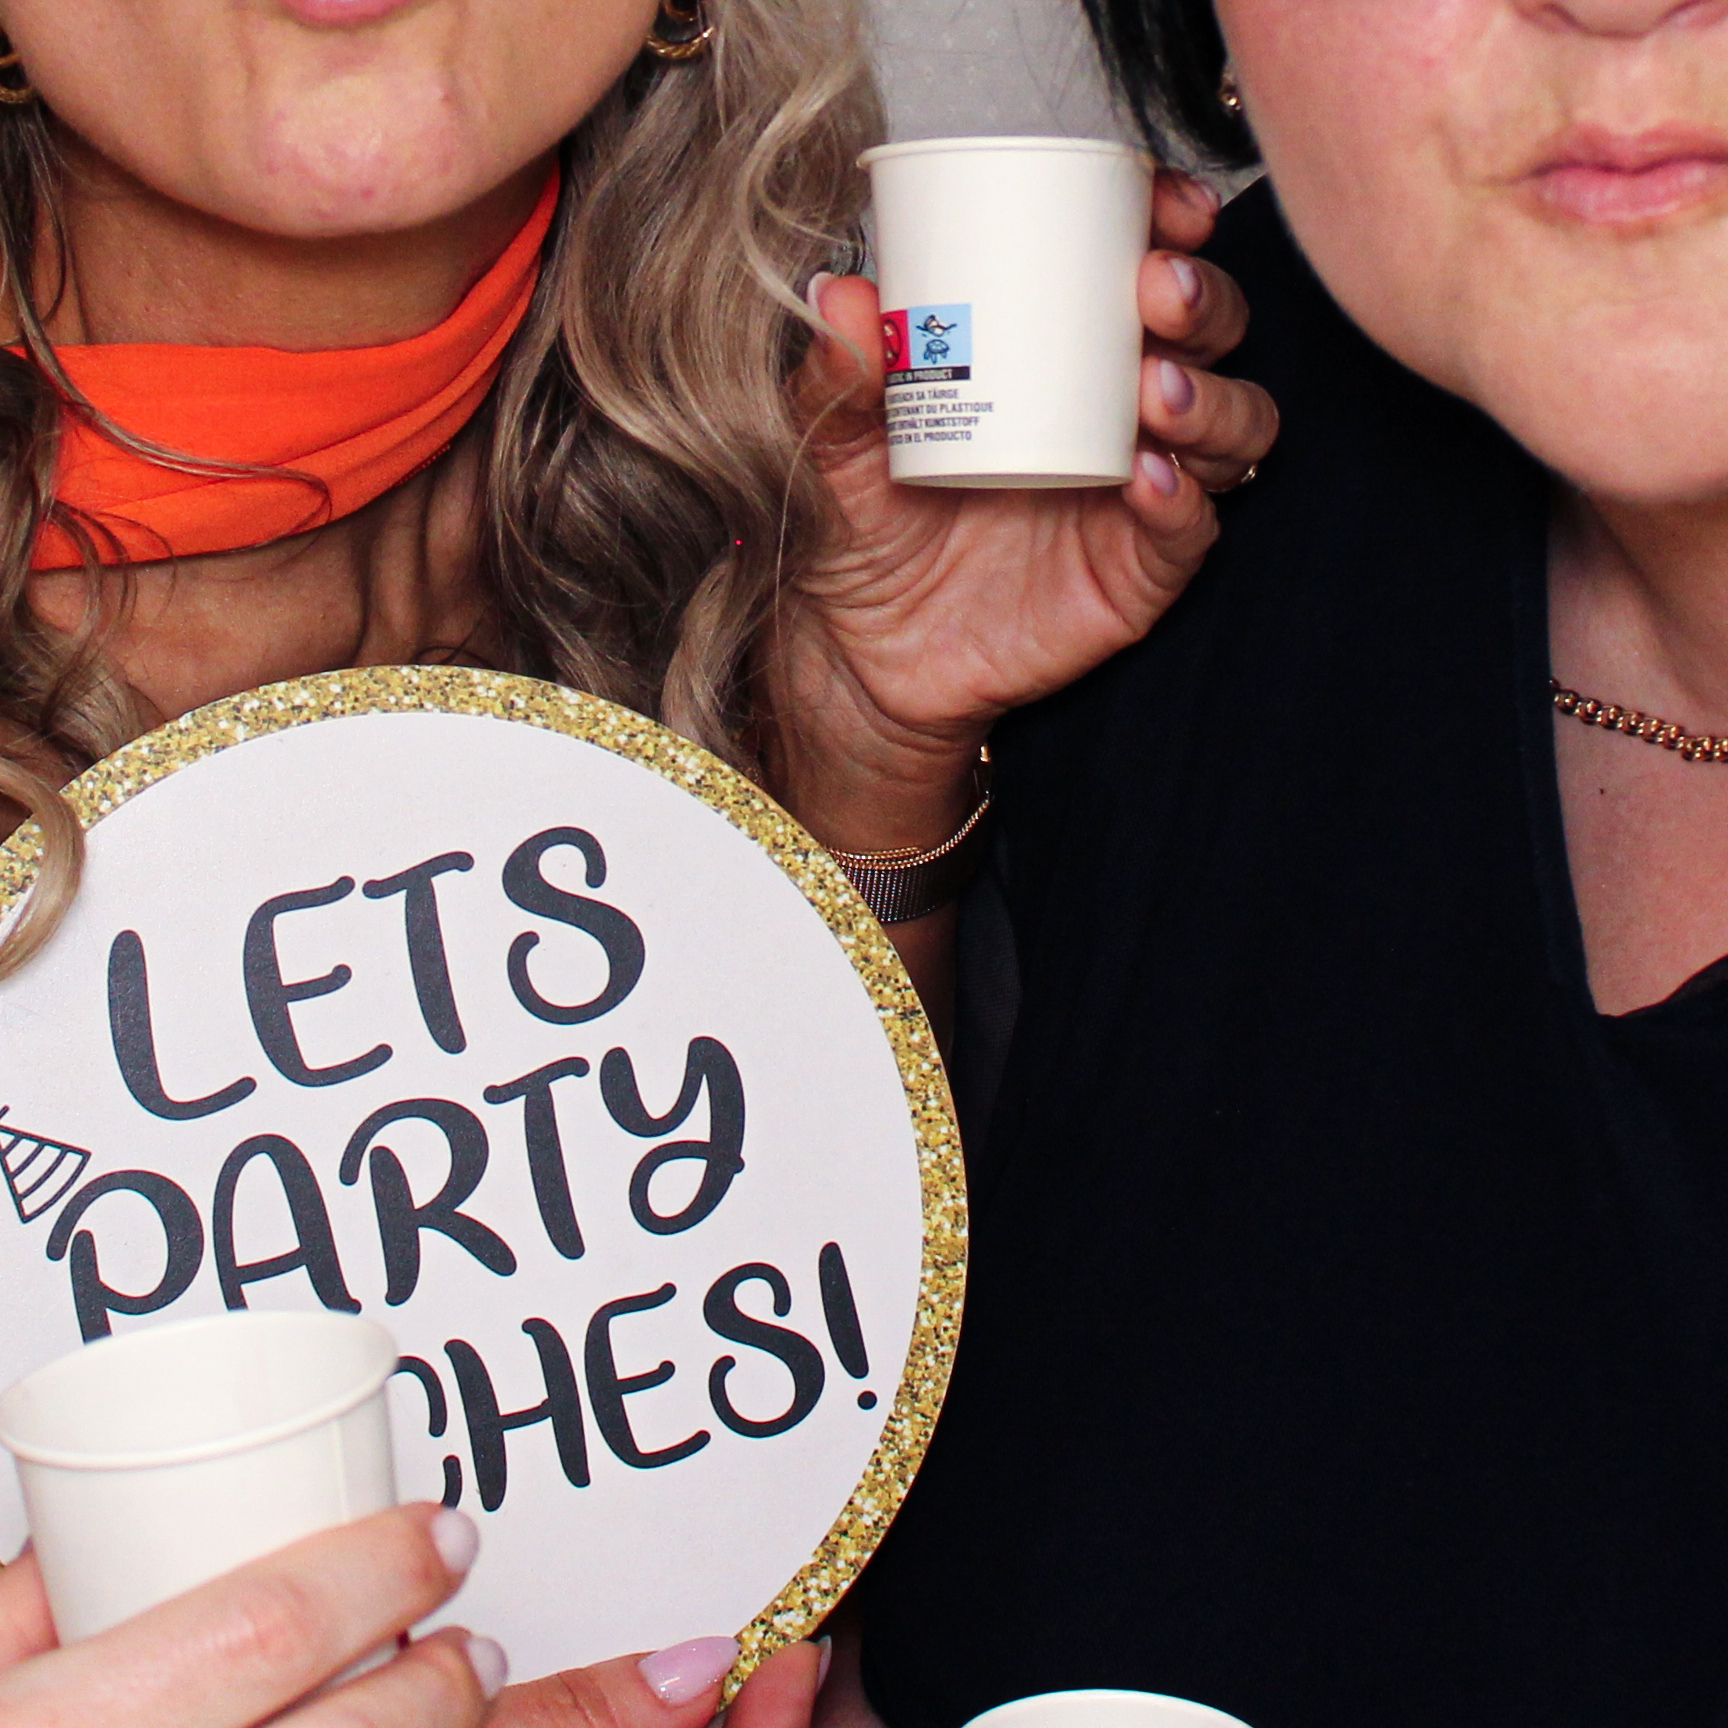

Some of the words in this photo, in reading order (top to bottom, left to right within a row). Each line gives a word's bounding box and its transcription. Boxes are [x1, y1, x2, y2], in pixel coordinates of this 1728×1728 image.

[914, 368, 952, 380] PRODUCT
[926, 404, 937, 414] DU
[939, 402, 993, 413] PLASTIQUE
[925, 417, 979, 428] KUNSTSTOFF
[914, 432, 922, 443] EL
[924, 431, 972, 442] PRODUCTO
[106, 825, 646, 1121] LETS
[45, 1036, 747, 1344] PARTY
